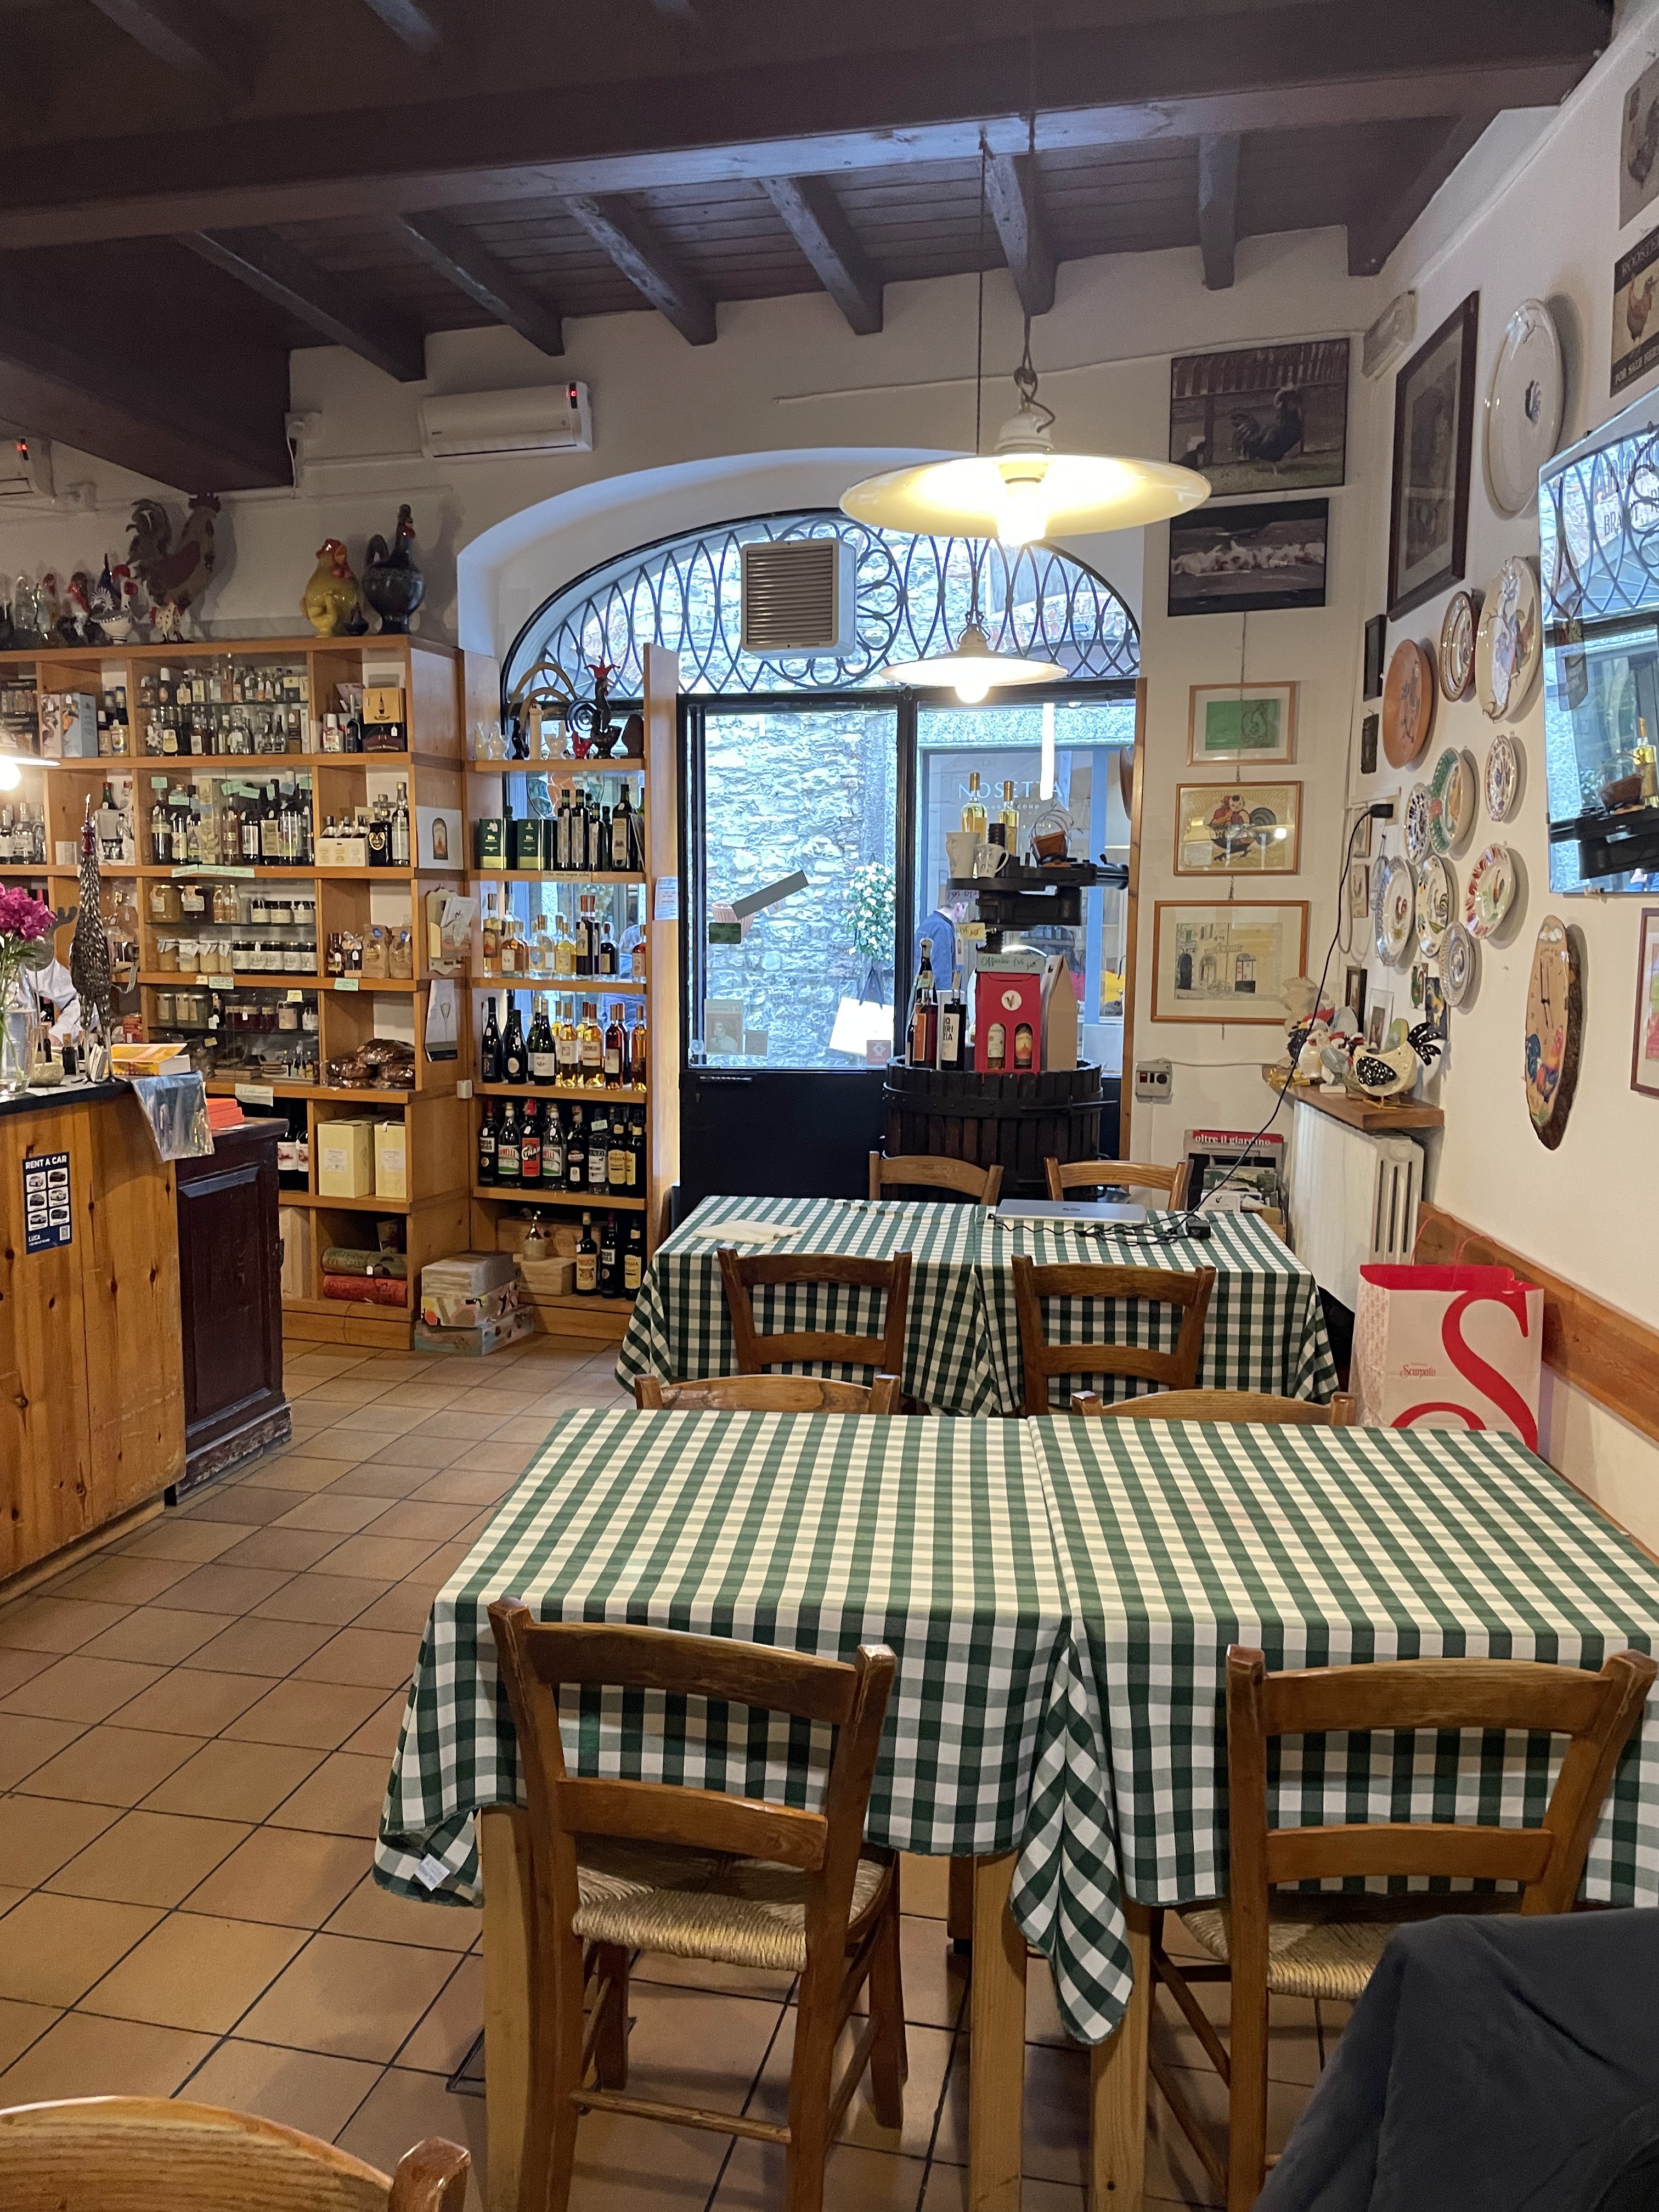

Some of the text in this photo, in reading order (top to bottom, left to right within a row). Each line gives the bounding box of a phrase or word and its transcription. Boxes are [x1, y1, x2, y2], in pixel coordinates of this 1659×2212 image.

[1195, 1133, 1218, 1143] oltre
[1221, 1134, 1227, 1144] il
[25, 1154, 67, 1170] RENT A CAR
